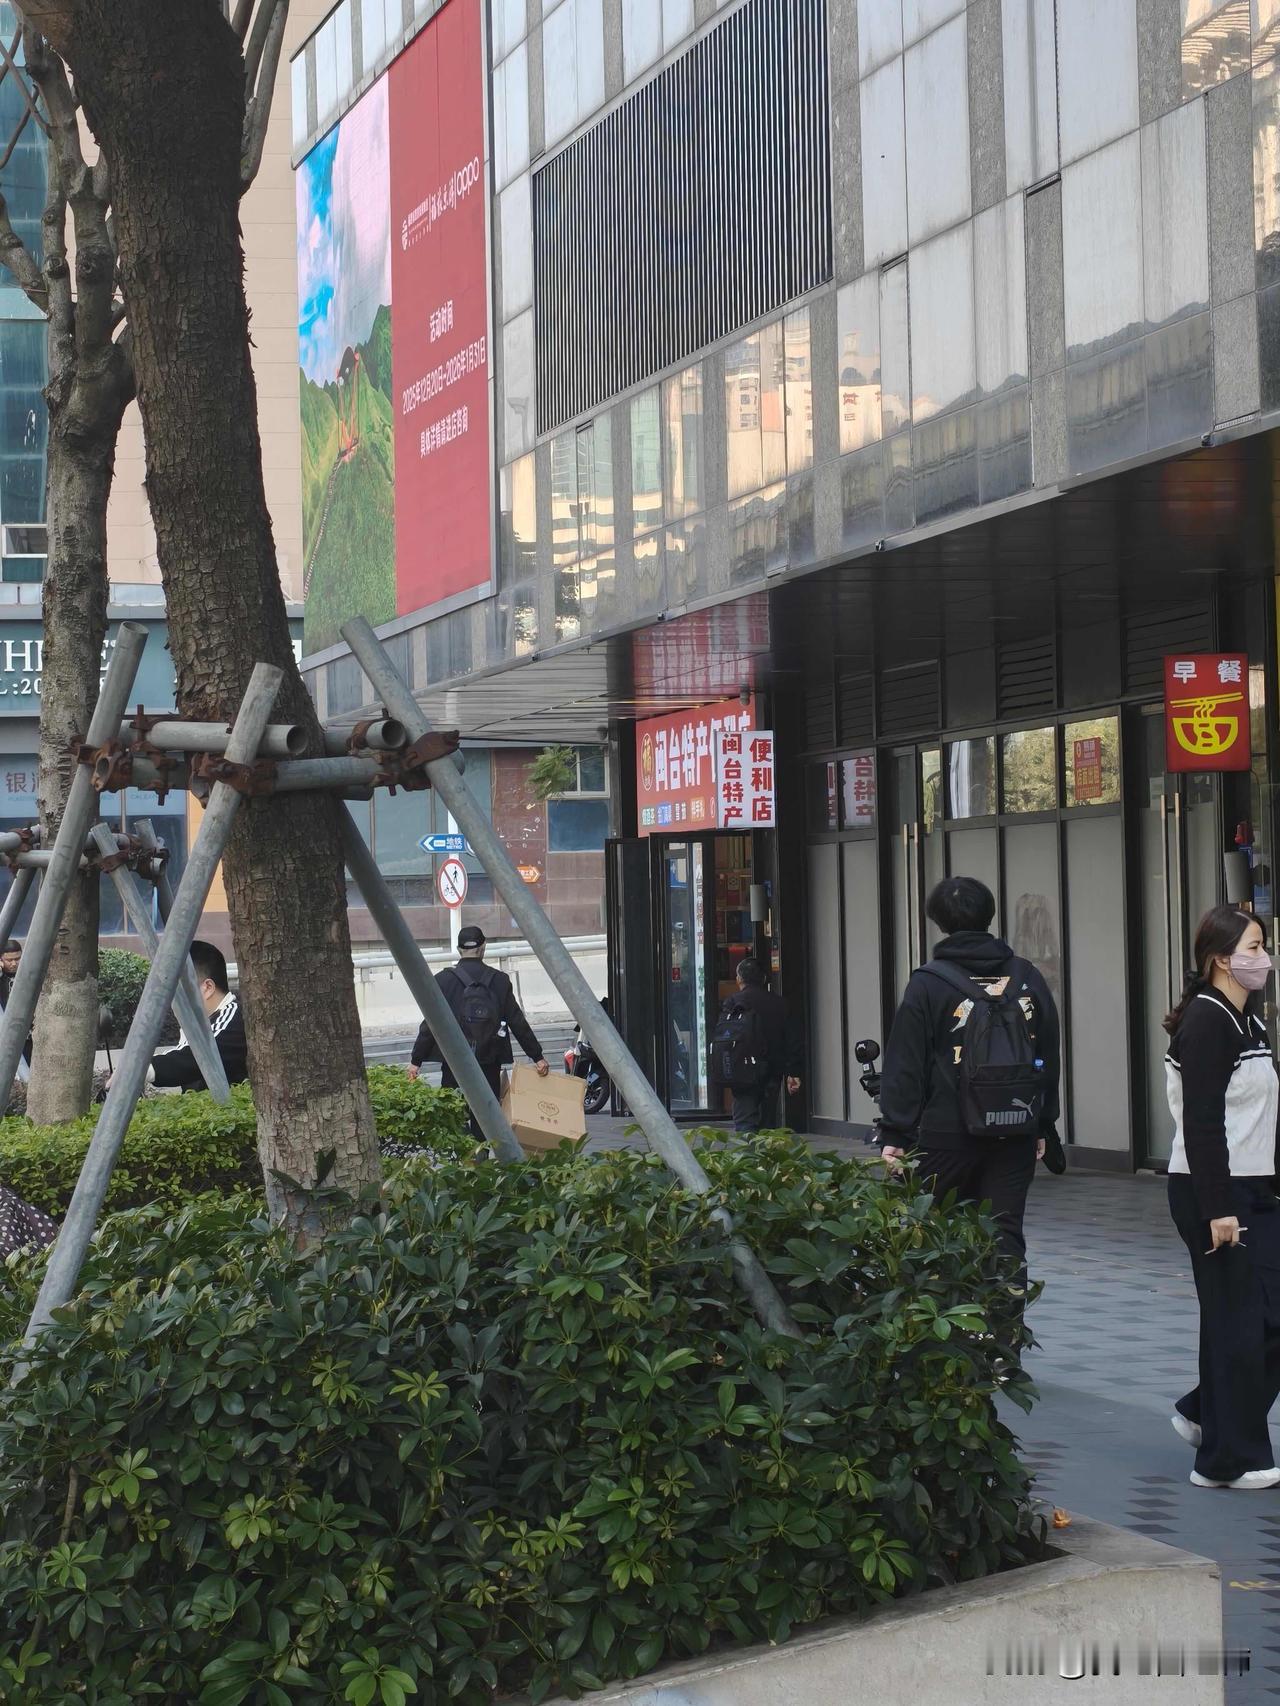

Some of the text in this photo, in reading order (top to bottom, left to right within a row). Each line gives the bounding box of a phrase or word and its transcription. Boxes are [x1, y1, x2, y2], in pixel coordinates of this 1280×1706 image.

[429, 299, 454, 343] 活动时间
[1172, 659, 1242, 685] 早餐
[722, 733, 744, 828] 闽台特产
[749, 738, 772, 822] 便利店
[985, 1110, 1028, 1127] PUMA
